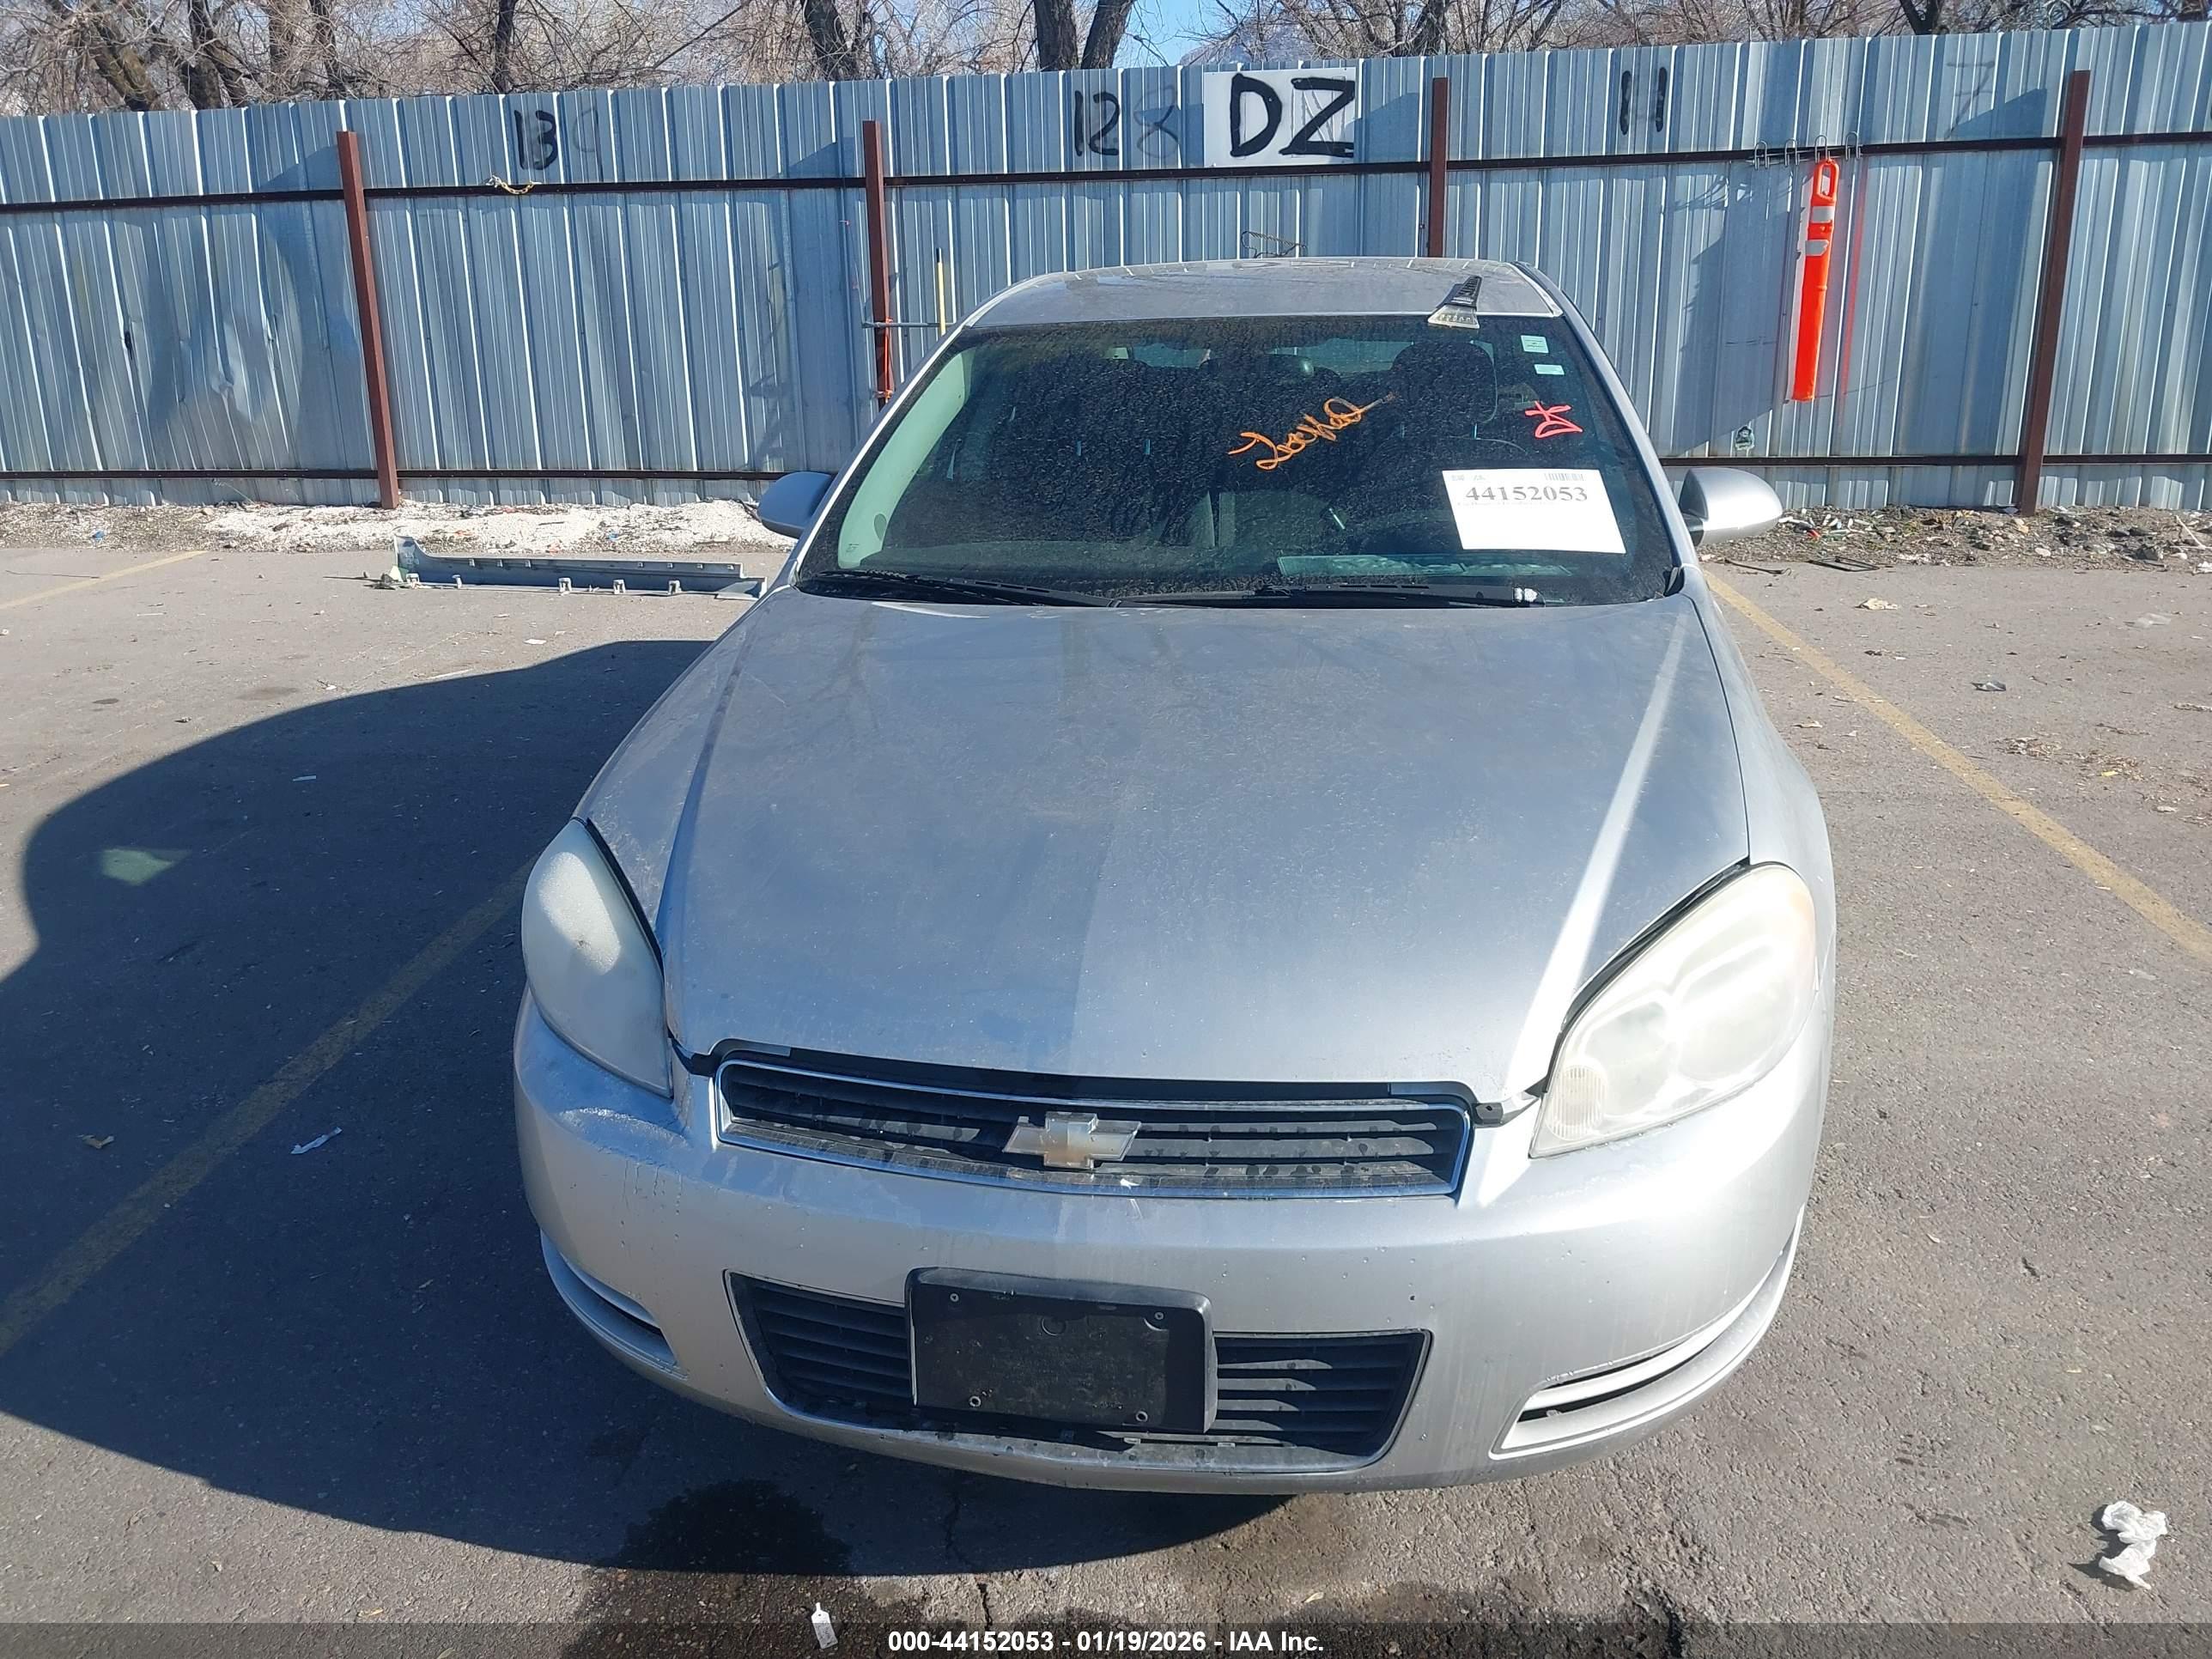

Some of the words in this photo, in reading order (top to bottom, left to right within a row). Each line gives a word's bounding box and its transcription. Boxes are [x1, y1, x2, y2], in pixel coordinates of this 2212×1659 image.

[1229, 72, 1356, 158] DZ
[1620, 66, 1668, 136] 11
[1465, 485, 1588, 501] 44152053
